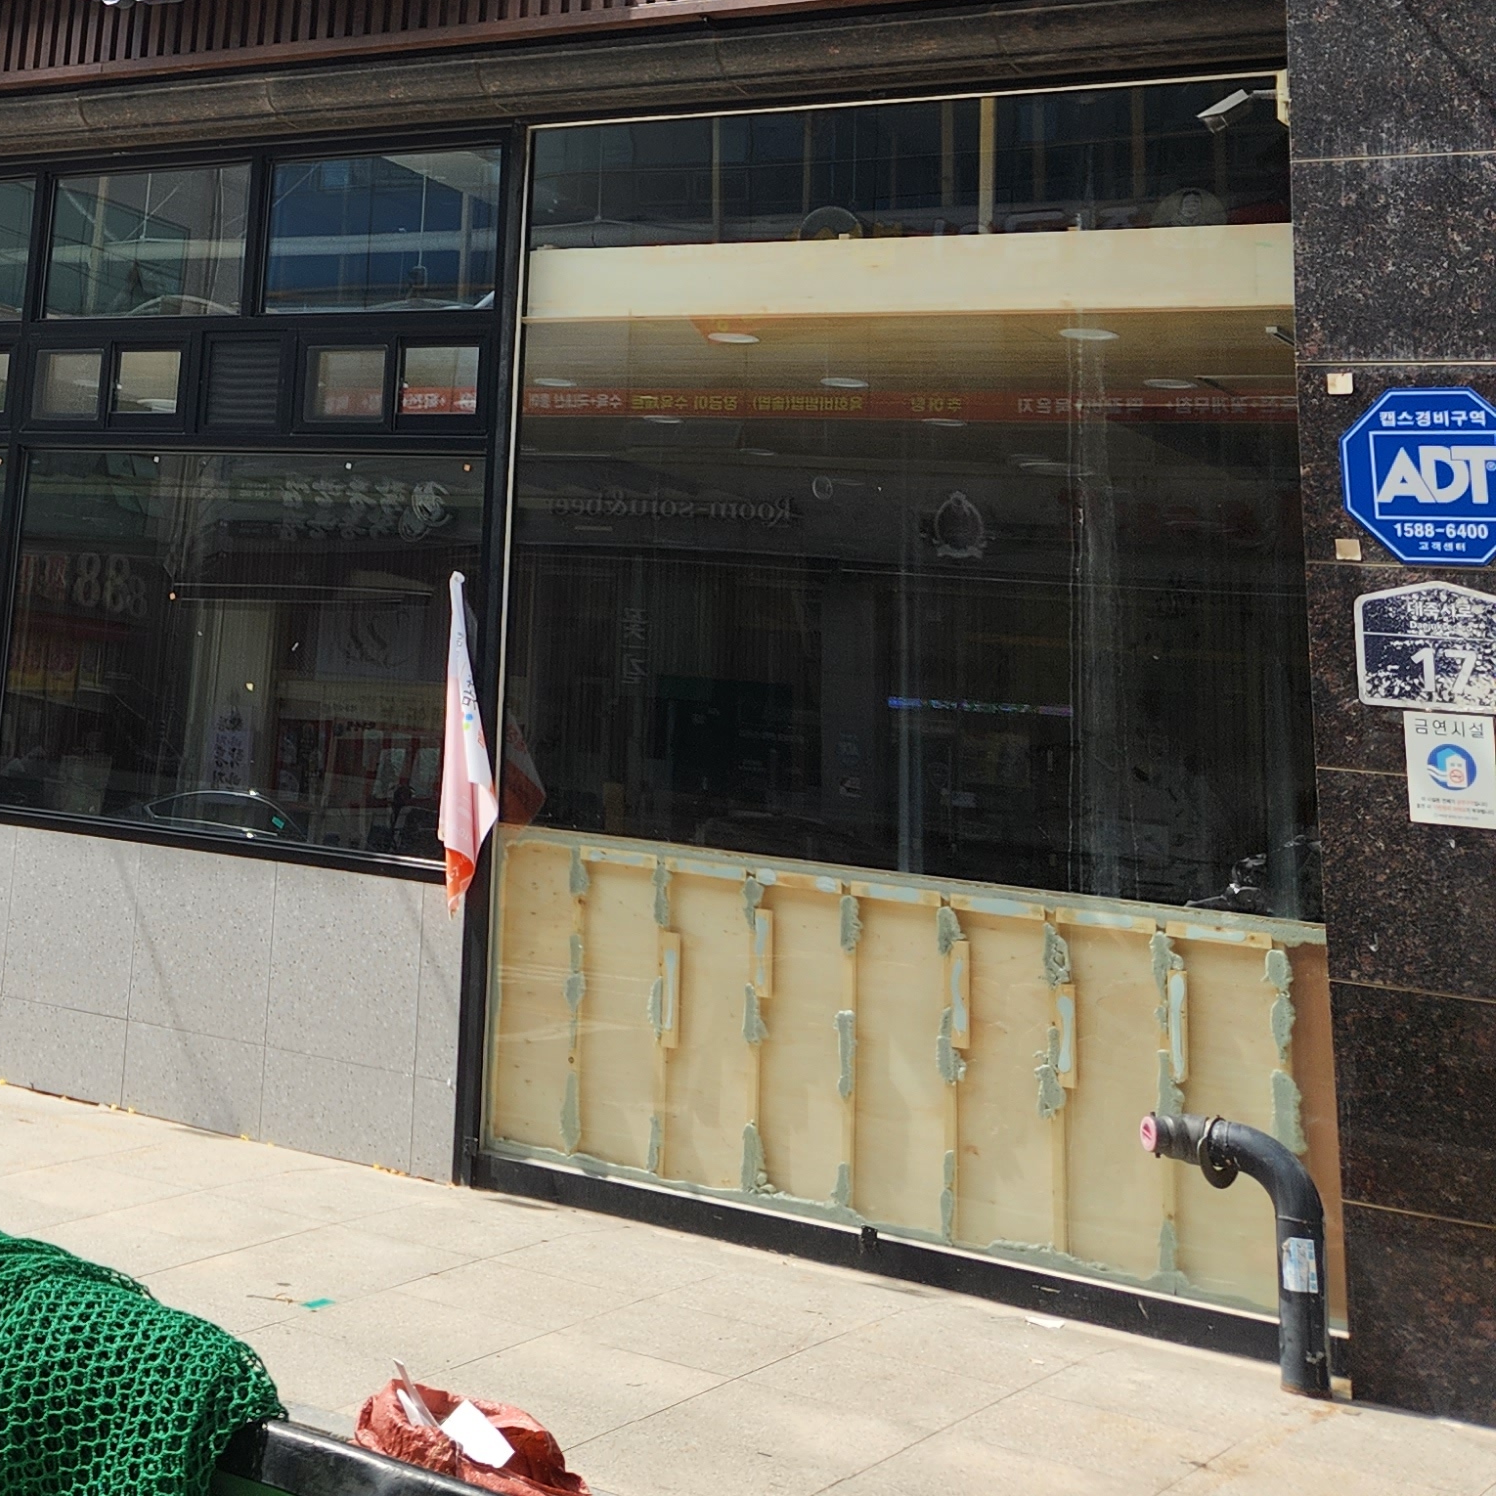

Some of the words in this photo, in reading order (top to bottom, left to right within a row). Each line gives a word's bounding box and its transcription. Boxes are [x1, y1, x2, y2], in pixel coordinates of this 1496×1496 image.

[1379, 409, 1486, 427] 캡스경비구역
[1377, 446, 1496, 504] ADT
[1393, 522, 1488, 539] 1588-6400
[1418, 541, 1466, 552] 고객센터
[1411, 647, 1477, 694] 17
[1415, 718, 1484, 739] 금연시설
